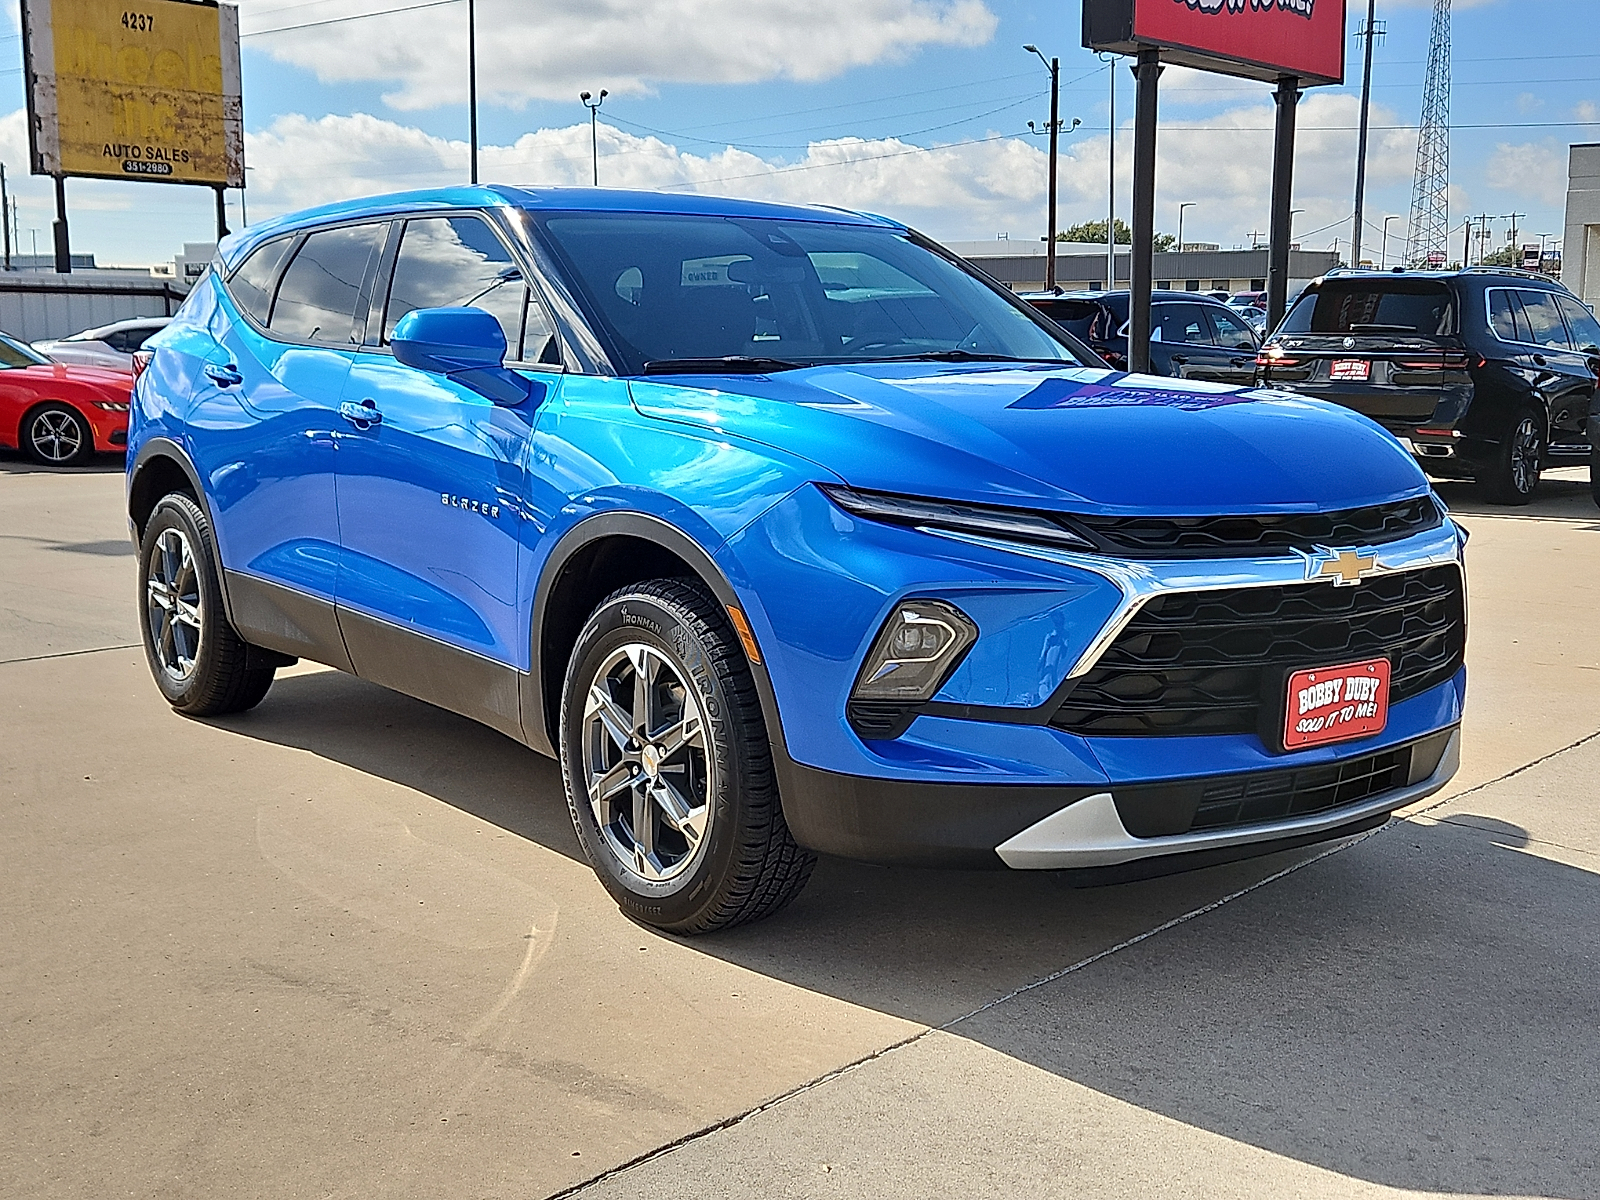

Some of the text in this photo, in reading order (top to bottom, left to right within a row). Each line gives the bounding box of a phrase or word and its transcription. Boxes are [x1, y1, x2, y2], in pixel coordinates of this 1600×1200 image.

[121, 11, 154, 31] 4237
[103, 143, 190, 163] AUTO SALES
[441, 493, 499, 518] BLAZER
[622, 614, 662, 635] IRONMAN
[1298, 676, 1380, 715] BOBBY DUBY
[1295, 702, 1378, 733] SOLD IT TO ME!
